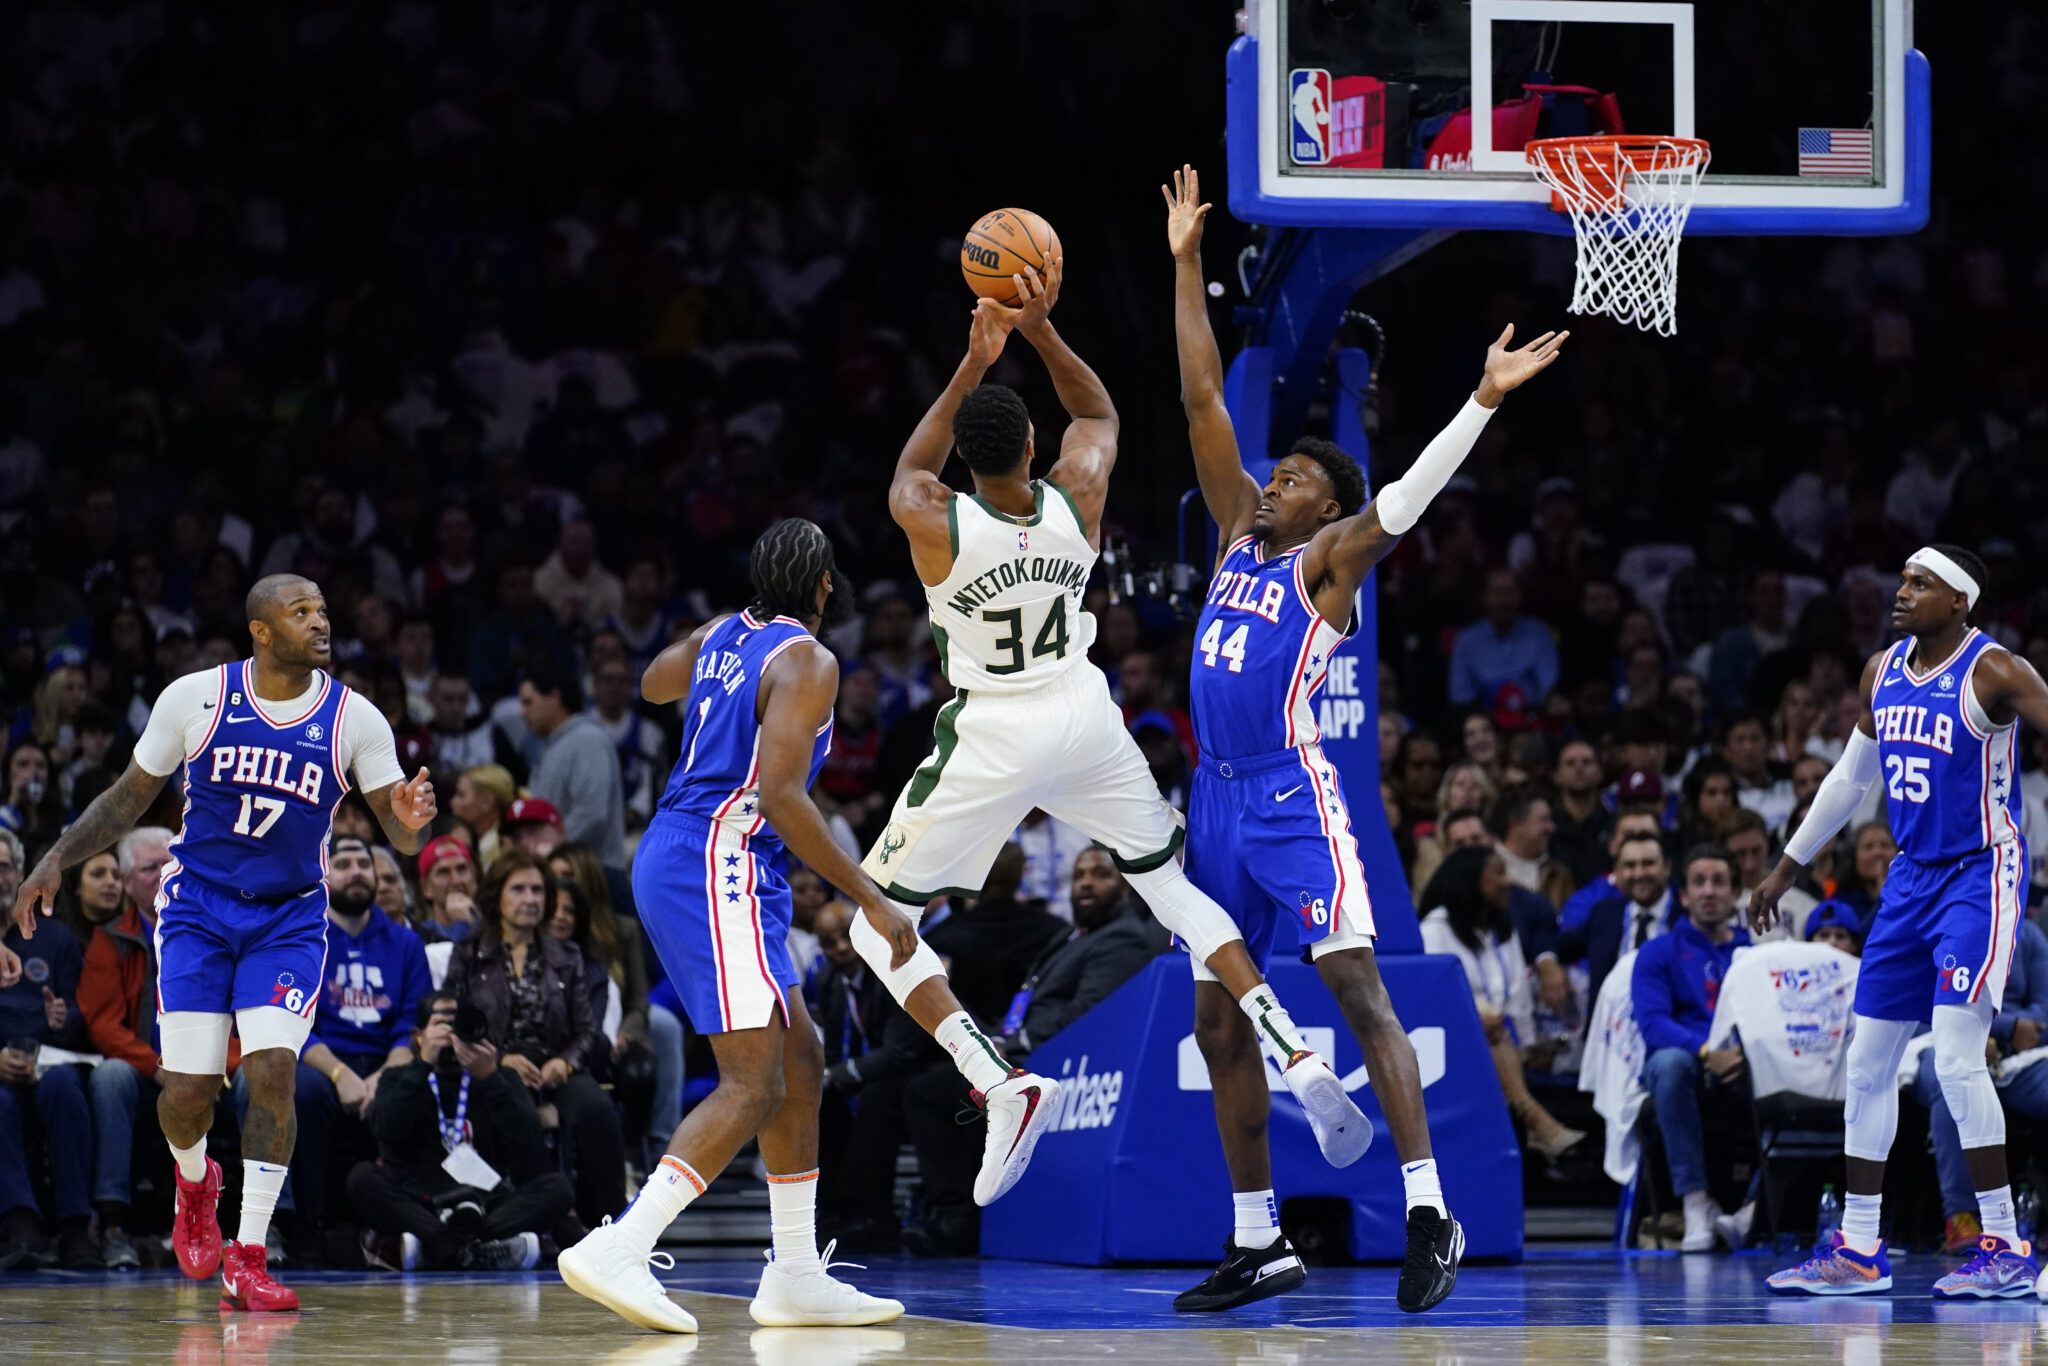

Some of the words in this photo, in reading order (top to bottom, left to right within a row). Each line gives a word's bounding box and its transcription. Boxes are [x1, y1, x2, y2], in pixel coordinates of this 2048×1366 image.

[1296, 142, 1317, 157] NBA
[962, 240, 999, 270] Wilso
[948, 557, 1087, 618] ANTETOKOUNM
[1208, 571, 1285, 624] PILA
[982, 593, 1069, 676] 34
[1200, 619, 1249, 673] 44
[696, 651, 746, 696] HAREN
[1322, 655, 1360, 696] HE
[1892, 656, 1903, 670] 6
[230, 692, 242, 706] 6
[1319, 699, 1365, 739] APP
[296, 739, 328, 751] crypto.com
[1874, 705, 1953, 755] PHILA
[210, 745, 324, 805] PHILA
[1885, 754, 1930, 803] 25
[233, 793, 286, 839] 17
[1301, 898, 1328, 929] 76
[270, 983, 304, 1012] 76
[1941, 966, 1970, 992] 76
[1047, 1054, 1123, 1133] inbase
